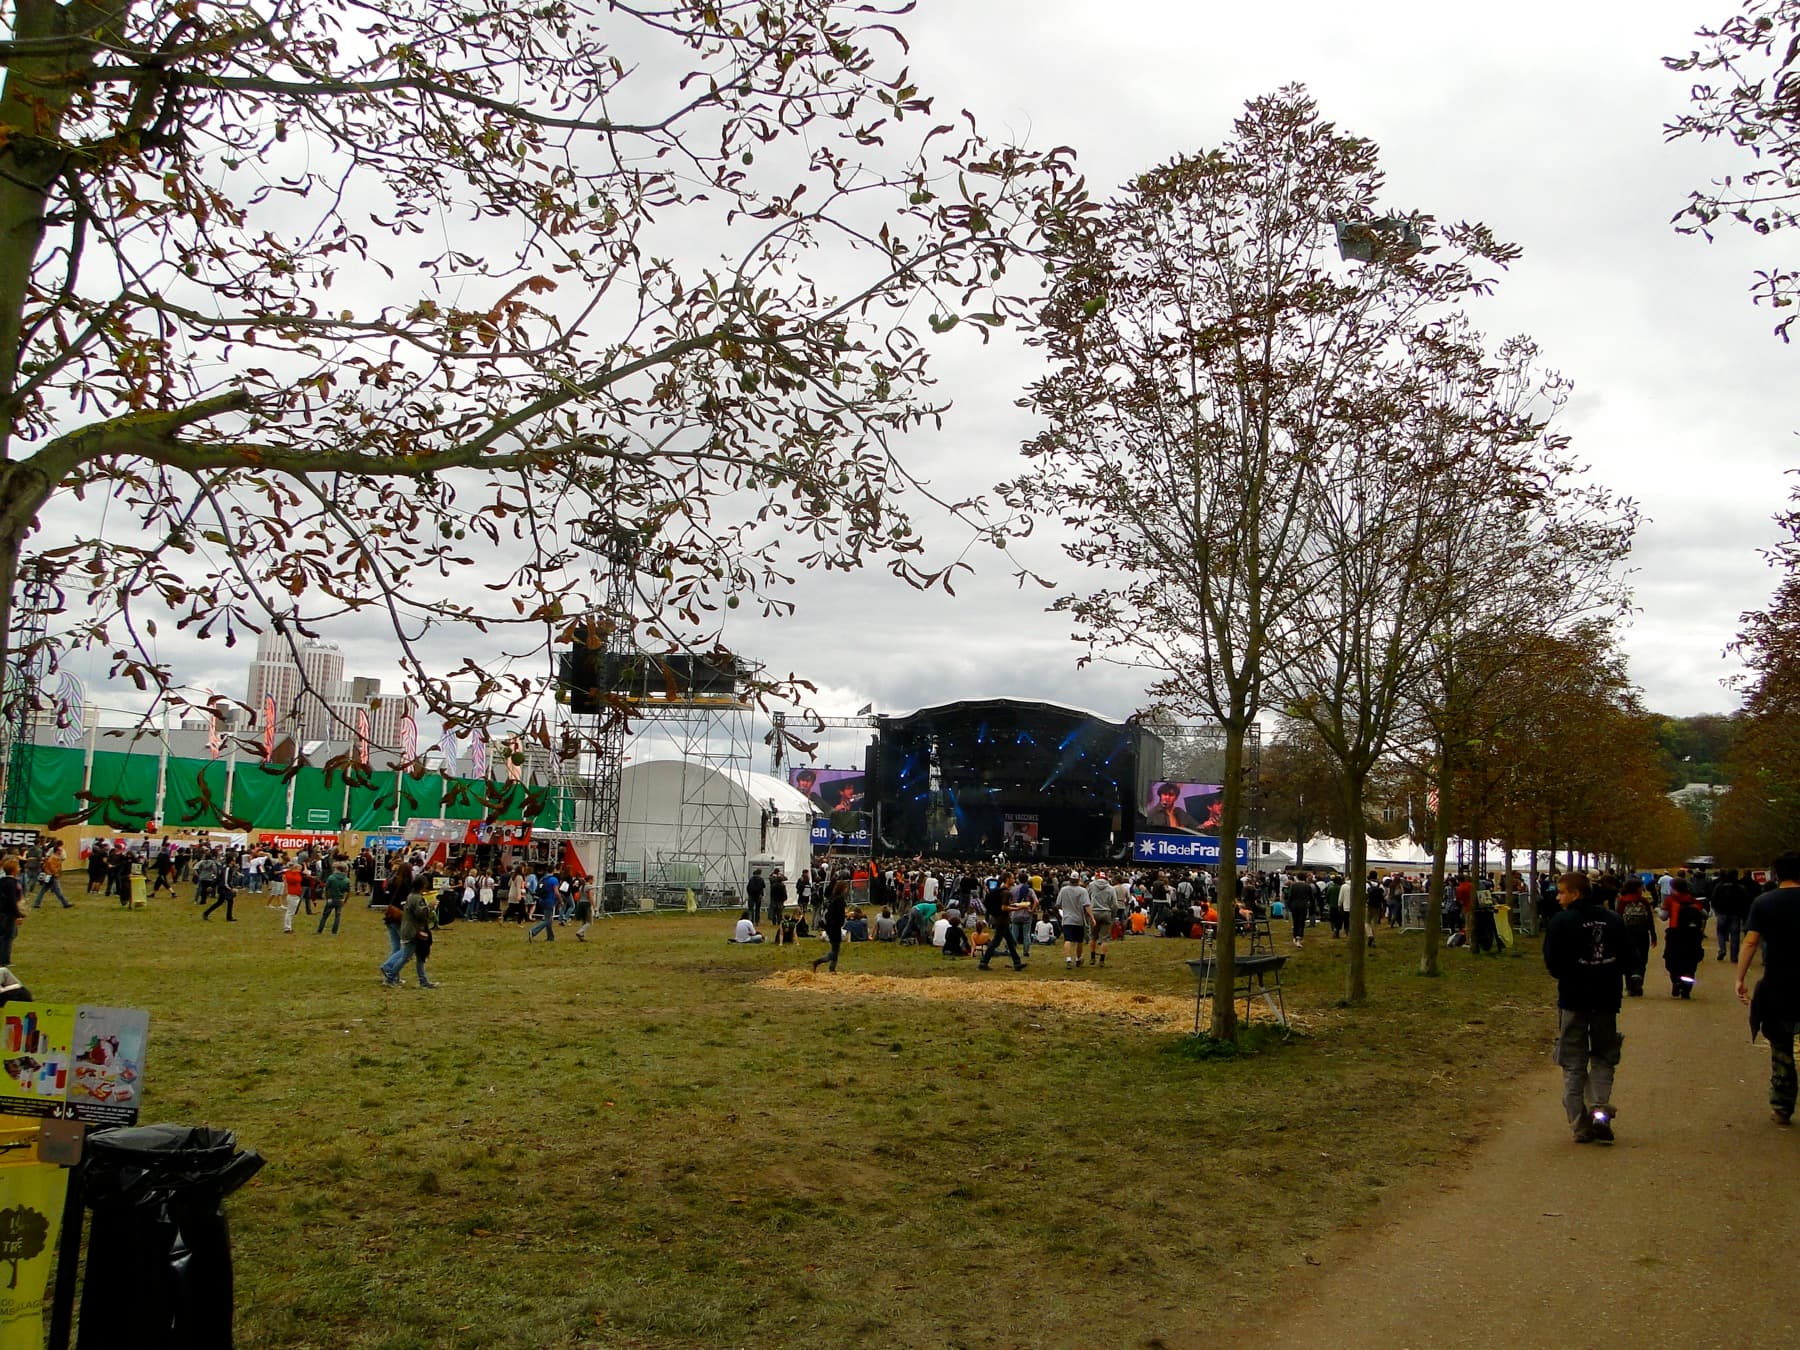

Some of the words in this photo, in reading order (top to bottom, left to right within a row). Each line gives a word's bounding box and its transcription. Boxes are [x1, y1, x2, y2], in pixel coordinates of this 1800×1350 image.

[1, 831, 36, 846] RSE
[811, 827, 827, 838] en
[273, 835, 309, 849] france
[1158, 841, 1244, 858] îledeFrae
